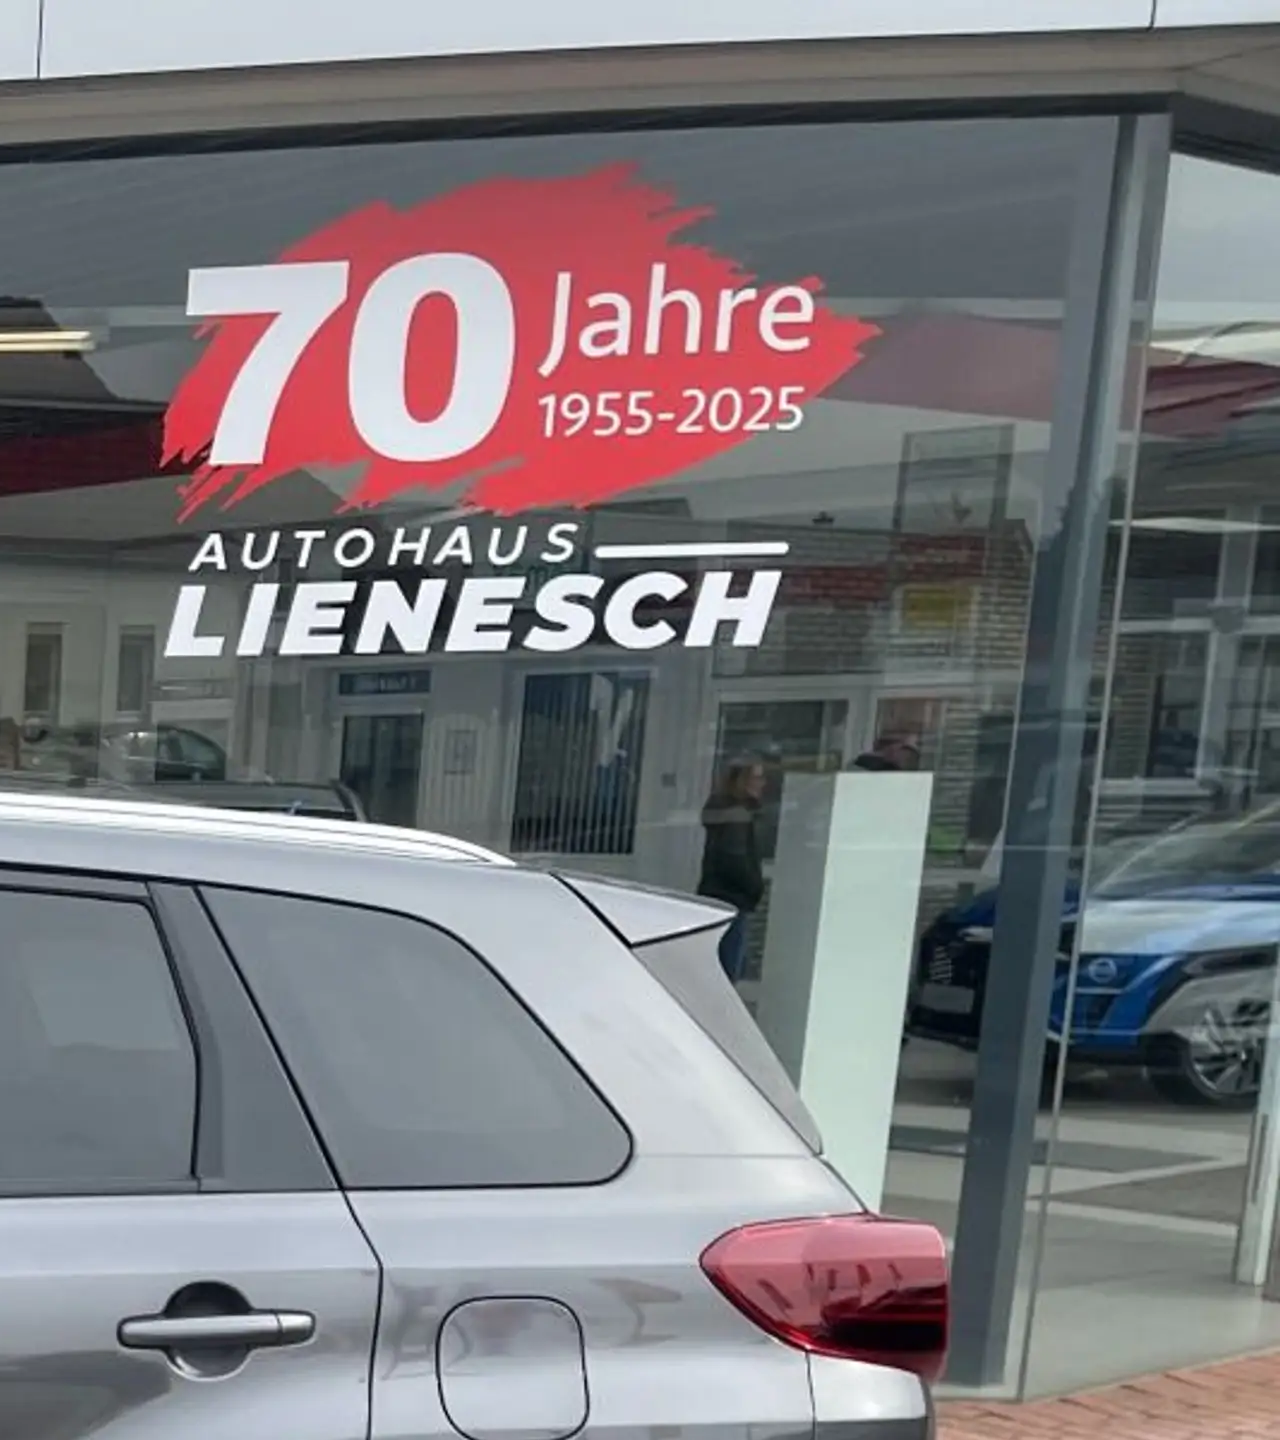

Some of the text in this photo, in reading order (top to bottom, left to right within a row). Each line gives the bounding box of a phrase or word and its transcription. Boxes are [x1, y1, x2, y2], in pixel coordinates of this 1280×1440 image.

[185, 252, 815, 466] 70 Jahre
[539, 386, 805, 438] 1955-2025
[188, 523, 580, 572] AUTOHAUS
[163, 570, 782, 658] LIENESCH
